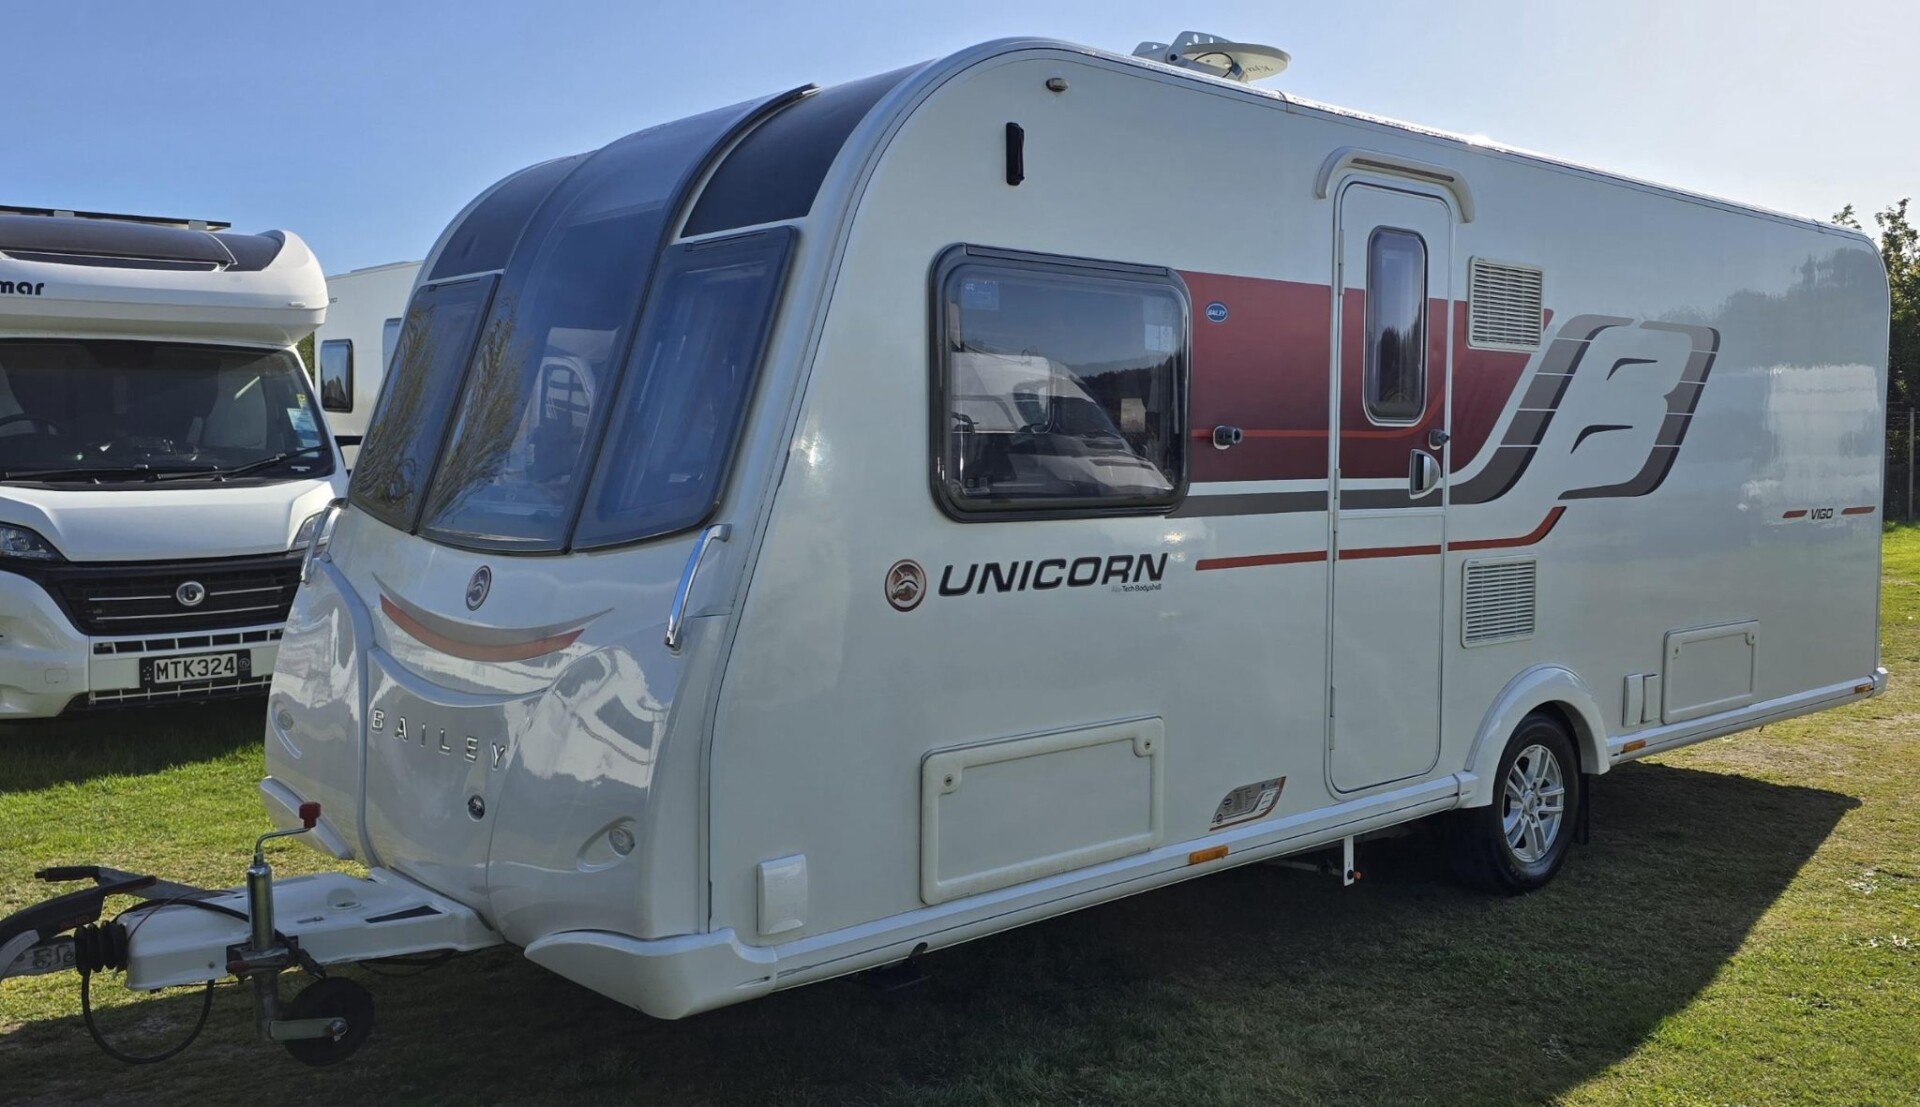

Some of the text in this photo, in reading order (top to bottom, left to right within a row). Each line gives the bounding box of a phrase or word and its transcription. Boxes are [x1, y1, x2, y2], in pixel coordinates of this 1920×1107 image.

[1811, 508, 1833, 520] VIGO
[938, 553, 1168, 597] UNICORN
[156, 656, 236, 681] MTK324
[370, 708, 506, 770] BAILEY
